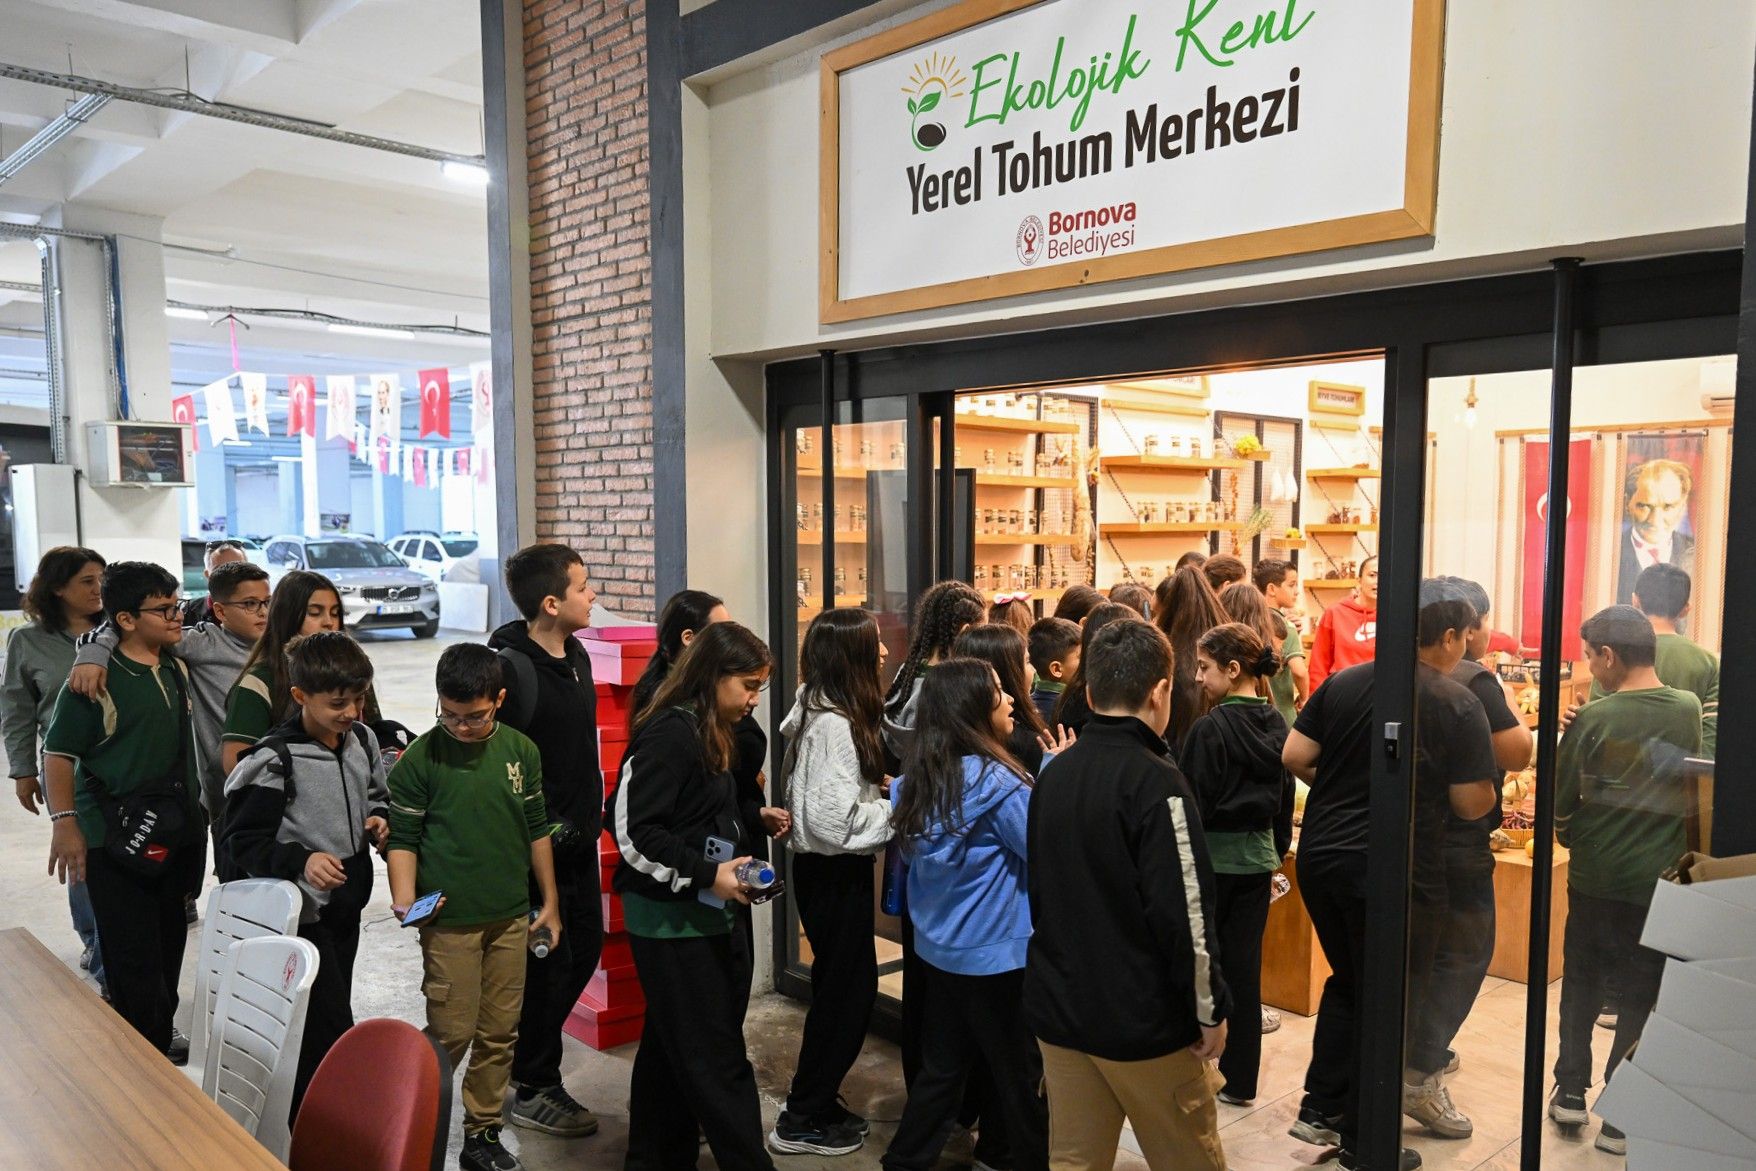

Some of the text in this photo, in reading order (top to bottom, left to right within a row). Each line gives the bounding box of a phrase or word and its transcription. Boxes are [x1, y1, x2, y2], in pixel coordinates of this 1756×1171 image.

[965, 14, 1151, 133] Ekolojik
[906, 66, 1301, 215] Yerel Tohum Merkezi
[1048, 202, 1137, 236] Bornova
[1048, 224, 1135, 260] Belediyesi
[125, 809, 158, 855] JORDAN
